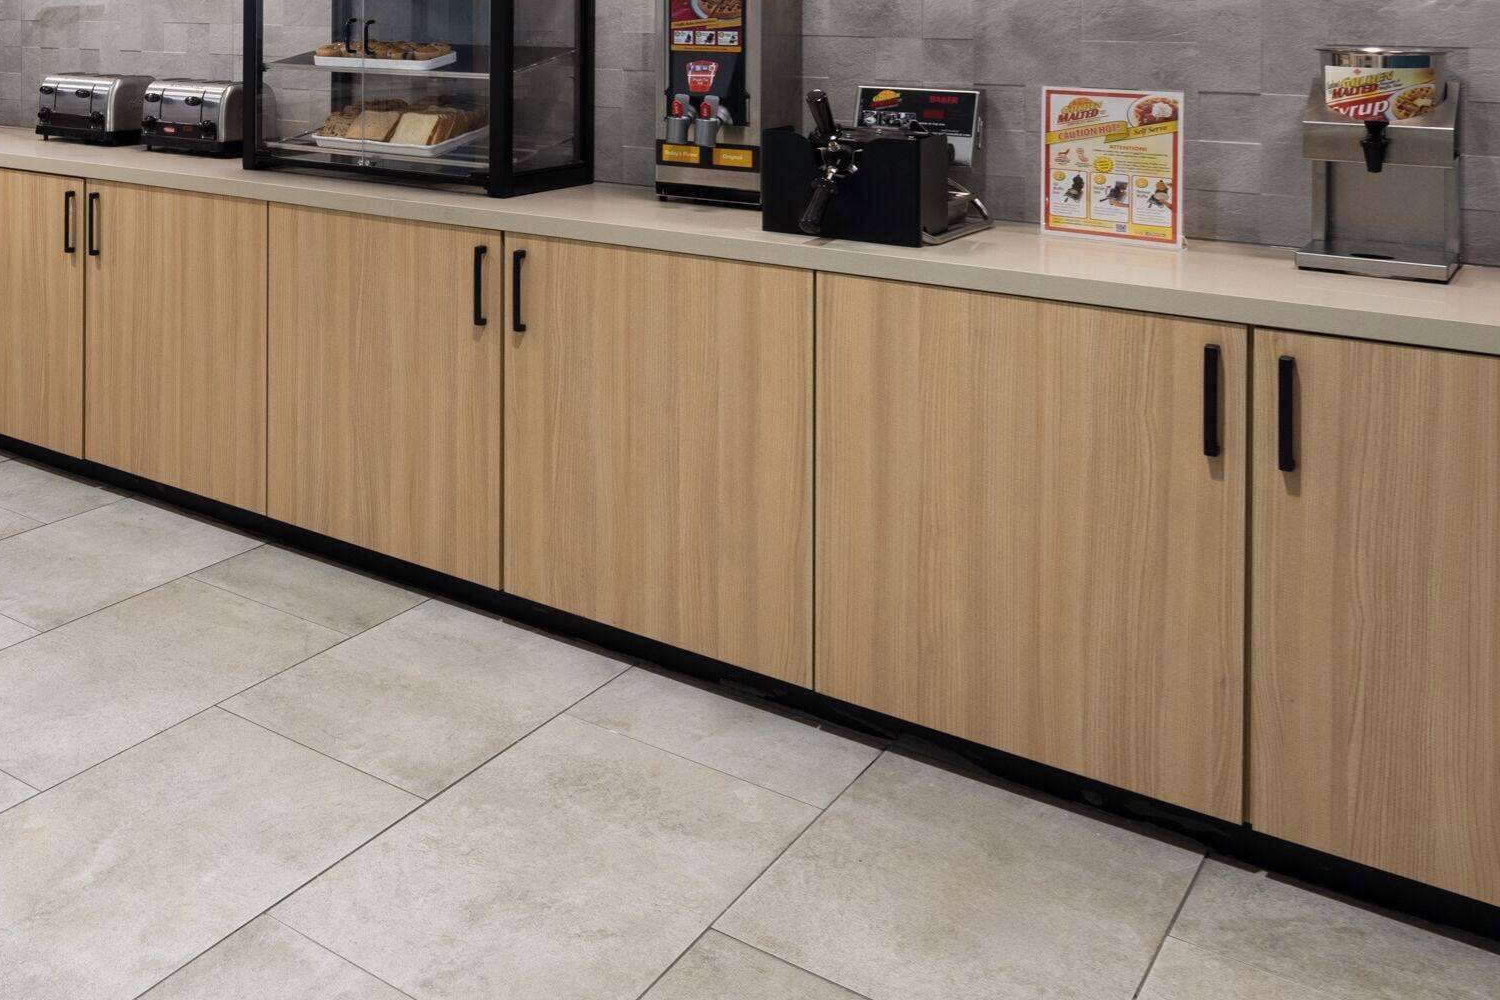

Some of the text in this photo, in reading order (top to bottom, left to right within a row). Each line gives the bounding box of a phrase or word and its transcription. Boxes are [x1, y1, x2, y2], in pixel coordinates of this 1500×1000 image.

[1340, 70, 1395, 89] GOLDEN
[1331, 82, 1380, 99] MALTED
[1057, 109, 1100, 124] MALTED
[1058, 127, 1098, 141] CAUTION
